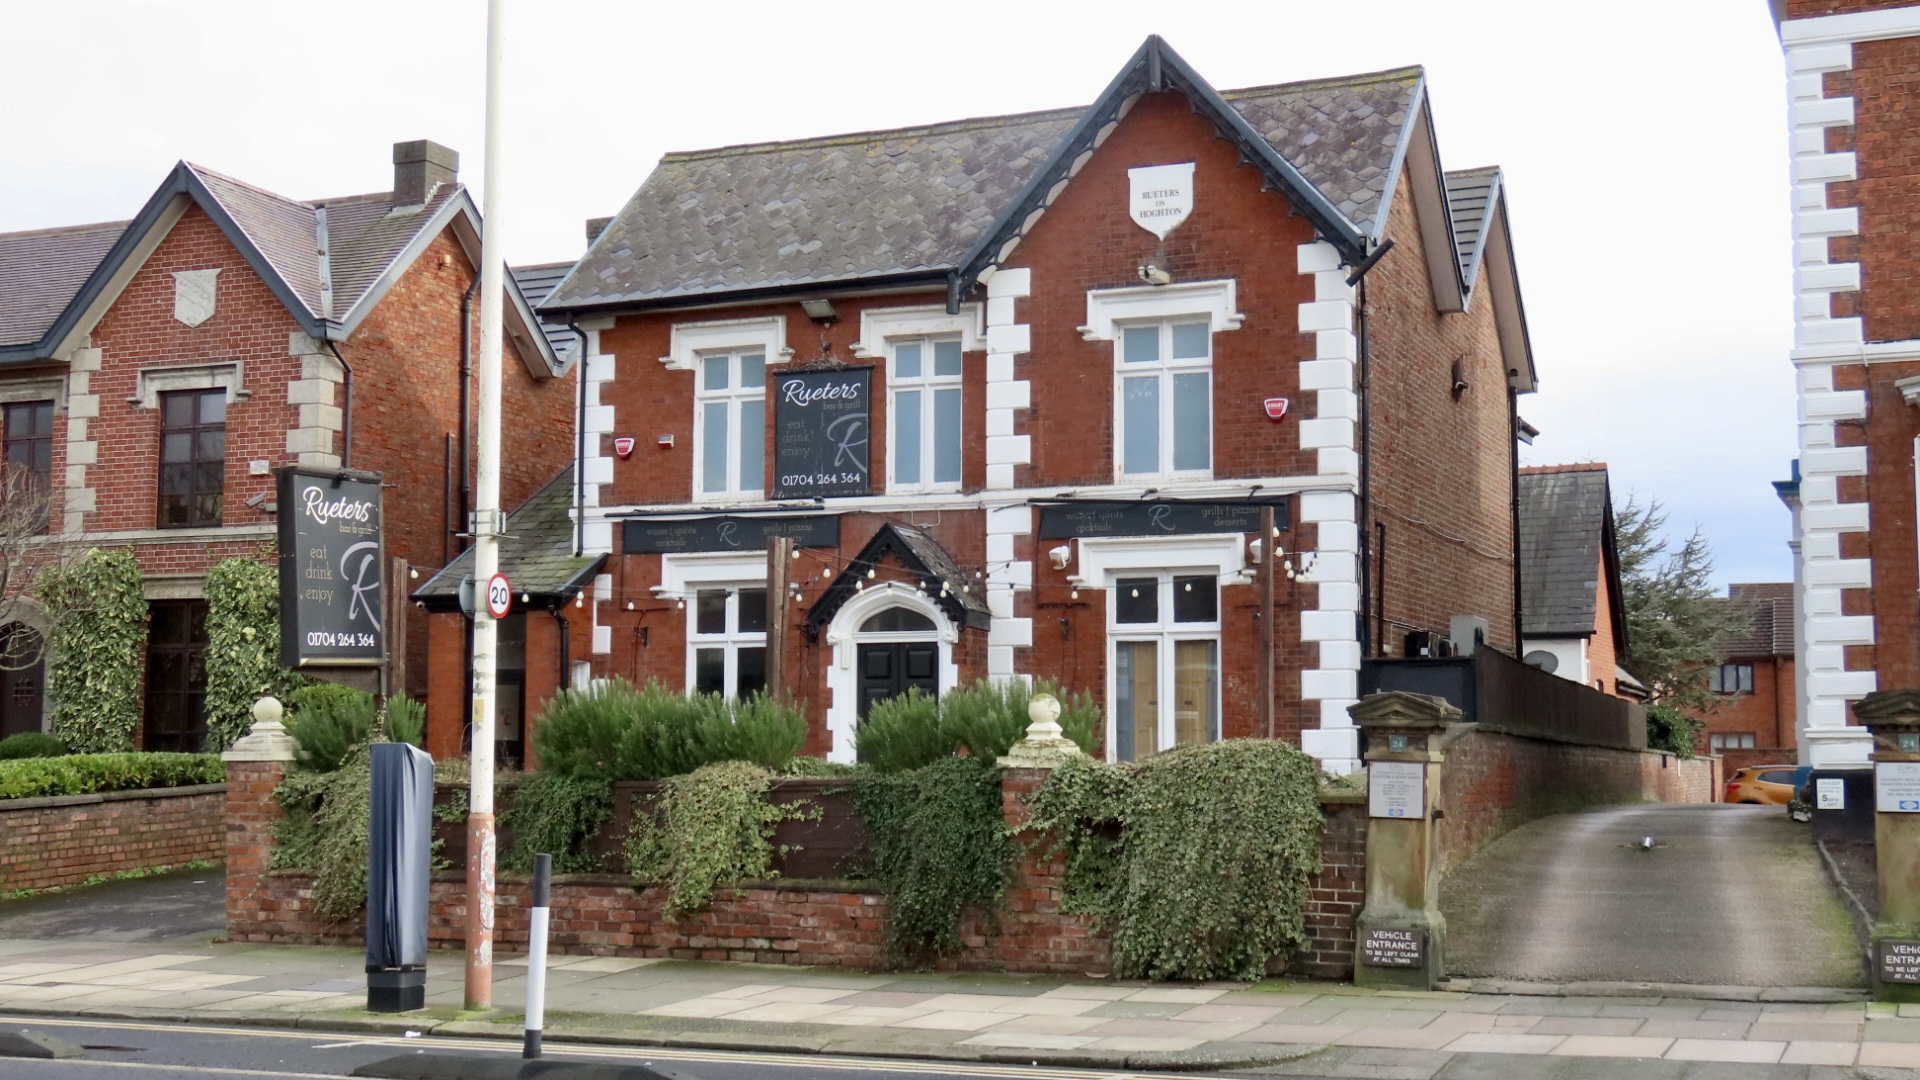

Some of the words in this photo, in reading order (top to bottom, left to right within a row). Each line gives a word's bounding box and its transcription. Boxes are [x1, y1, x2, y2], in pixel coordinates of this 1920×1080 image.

[1142, 189, 1180, 199] RUETERS
[1140, 207, 1182, 218] HOGHTON
[782, 379, 861, 407] Rueters
[823, 401, 836, 410] bar
[844, 399, 860, 411] grill
[787, 418, 804, 429] eat
[782, 429, 810, 443] drink
[781, 447, 810, 459] enjoy
[781, 474, 814, 486] 01704
[817, 473, 837, 485] 264
[840, 472, 861, 484] 364
[303, 486, 372, 525] Rueters
[1201, 505, 1224, 519] grills
[1231, 505, 1260, 517] pizzas
[1147, 504, 1176, 531] R
[1213, 517, 1247, 526] desserts
[339, 521, 351, 533] bar
[716, 521, 742, 546] R
[788, 524, 813, 534] pizzas
[1076, 521, 1112, 532] cocktails
[310, 544, 327, 559] eat
[305, 560, 333, 580] drink
[305, 586, 334, 606] enjoy
[491, 586, 508, 605] 20
[307, 632, 336, 646] 01704
[338, 633, 355, 646] 264
[358, 633, 375, 647] 364
[1902, 740, 1914, 748] 24
[1366, 940, 1418, 950] ENTRANCE
